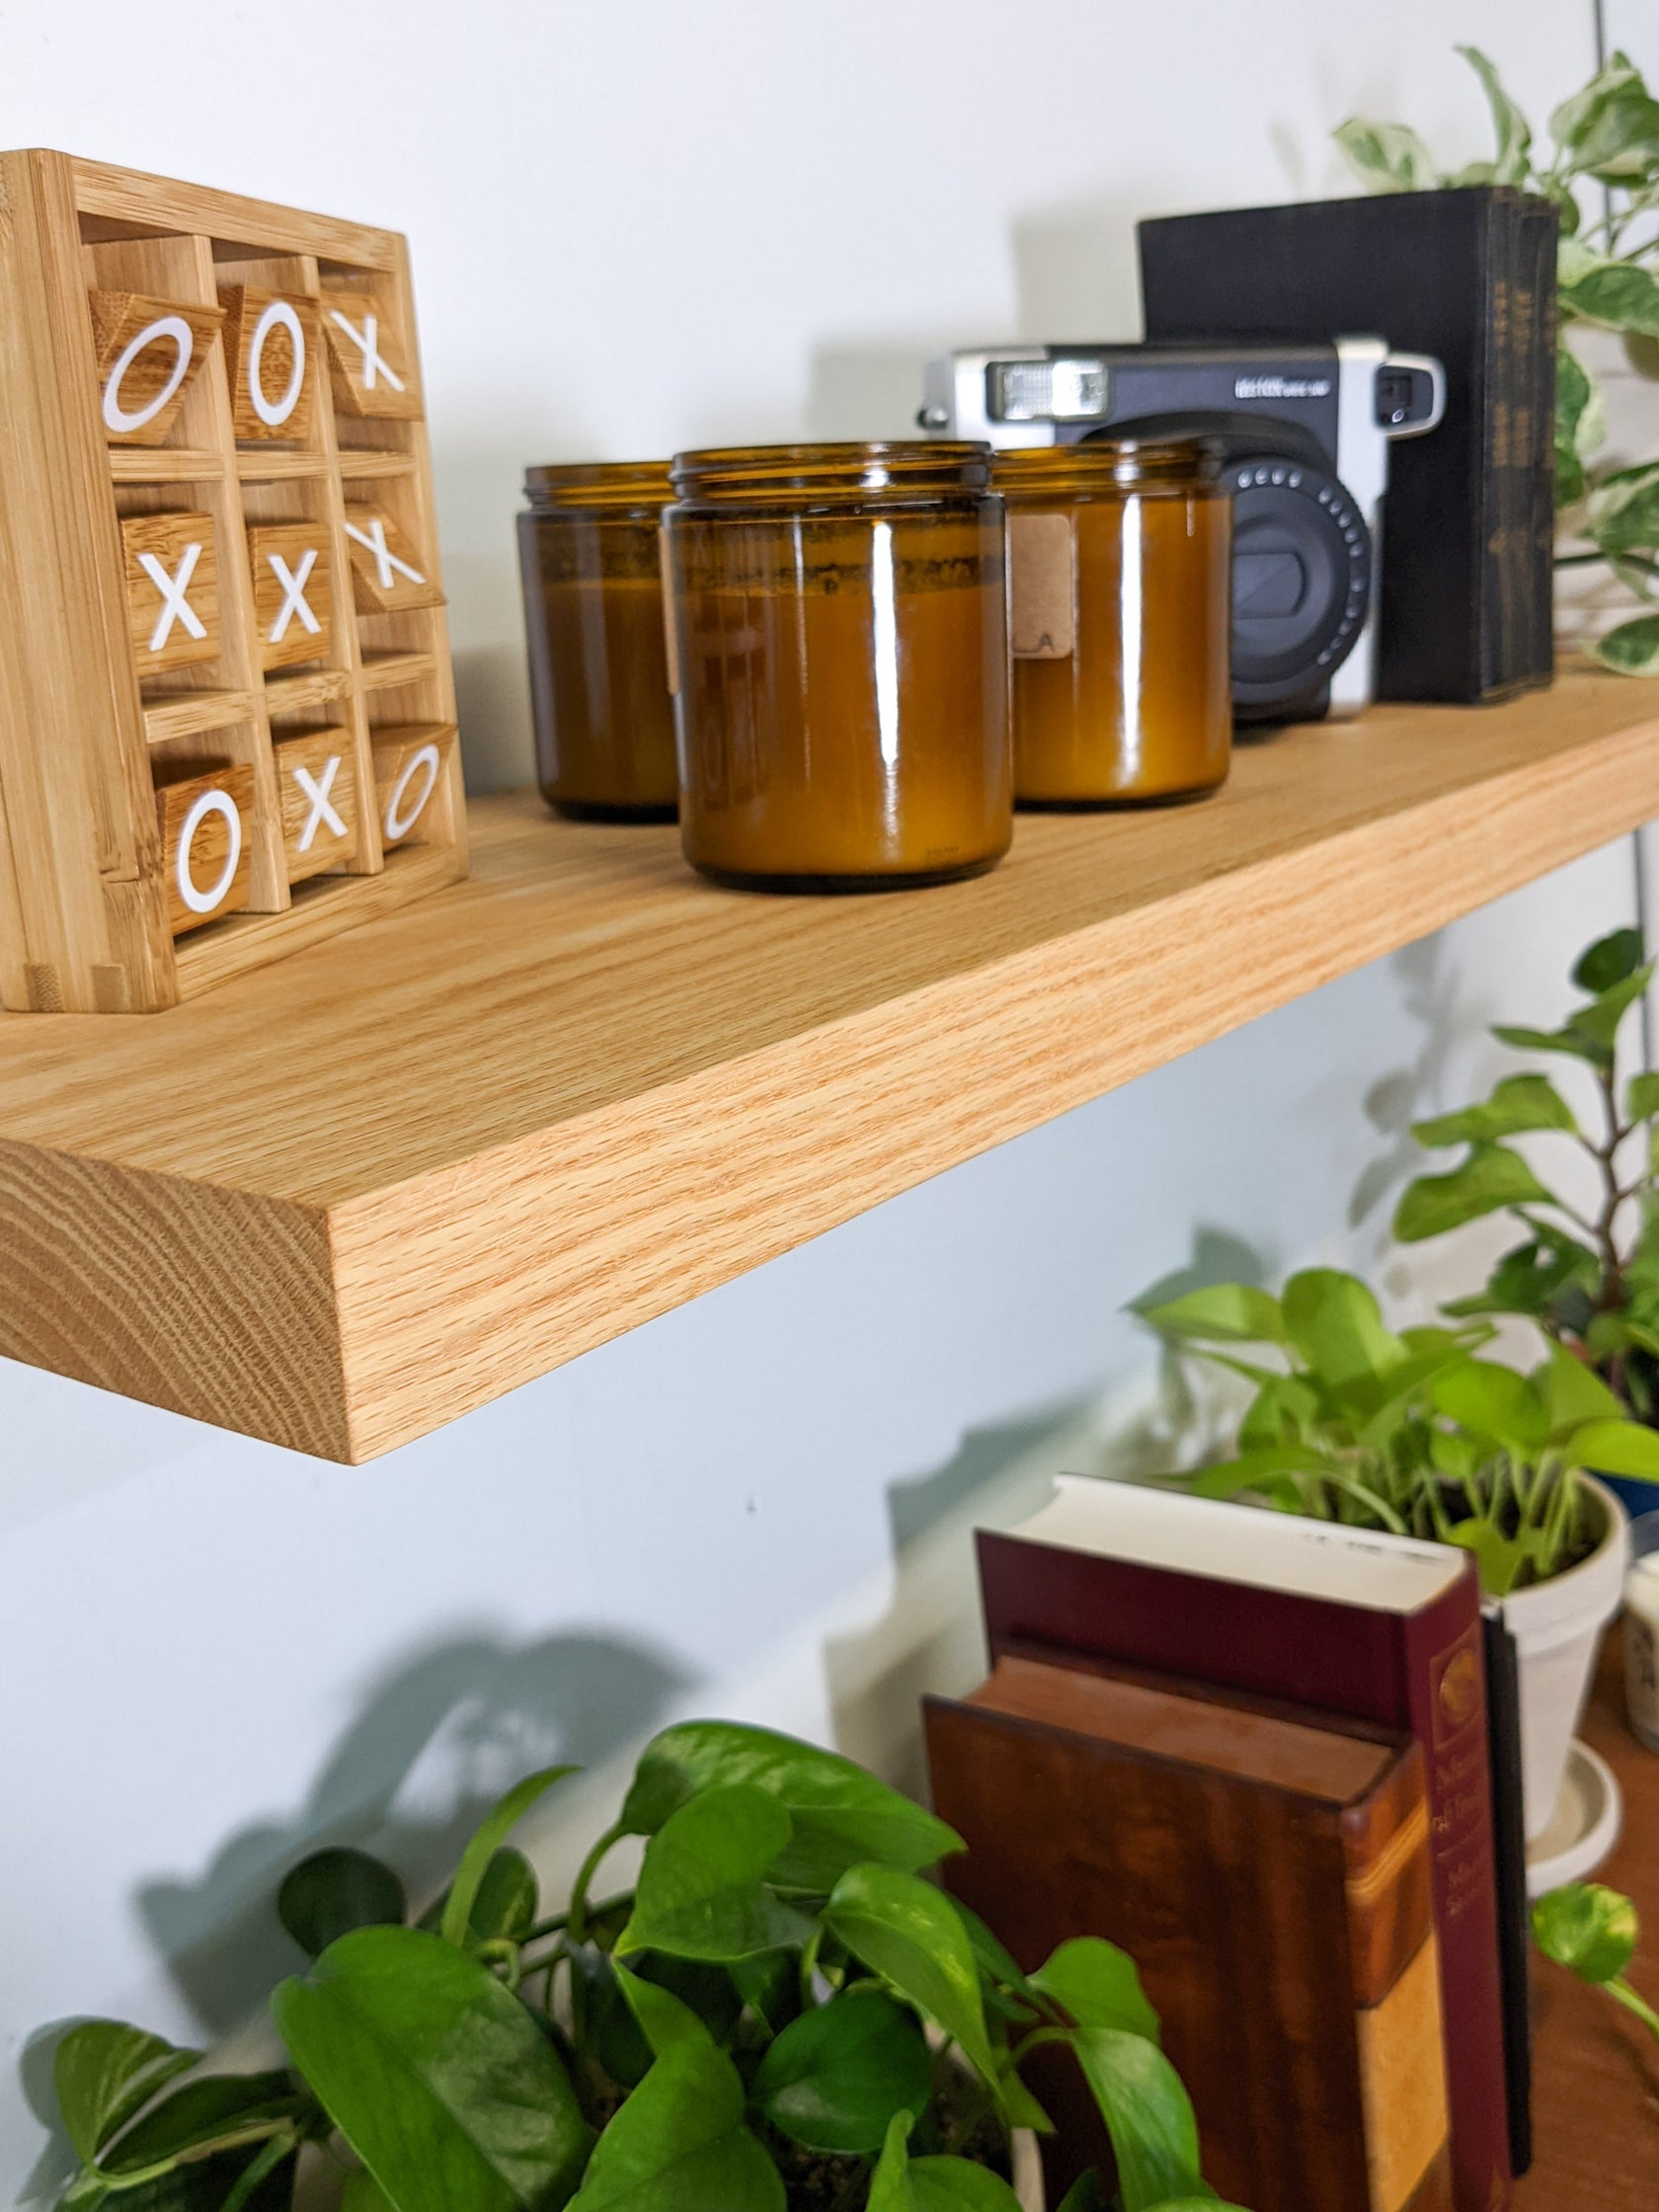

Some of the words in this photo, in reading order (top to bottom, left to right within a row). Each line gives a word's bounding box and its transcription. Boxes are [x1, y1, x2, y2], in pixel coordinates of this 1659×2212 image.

[102, 316, 193, 433] O
[248, 300, 305, 427] O
[330, 310, 405, 392] X
[137, 542, 207, 652] X
[268, 549, 321, 643] X
[344, 519, 426, 589] X
[175, 789, 242, 913] O
[293, 755, 348, 853] X
[386, 745, 439, 839] O
